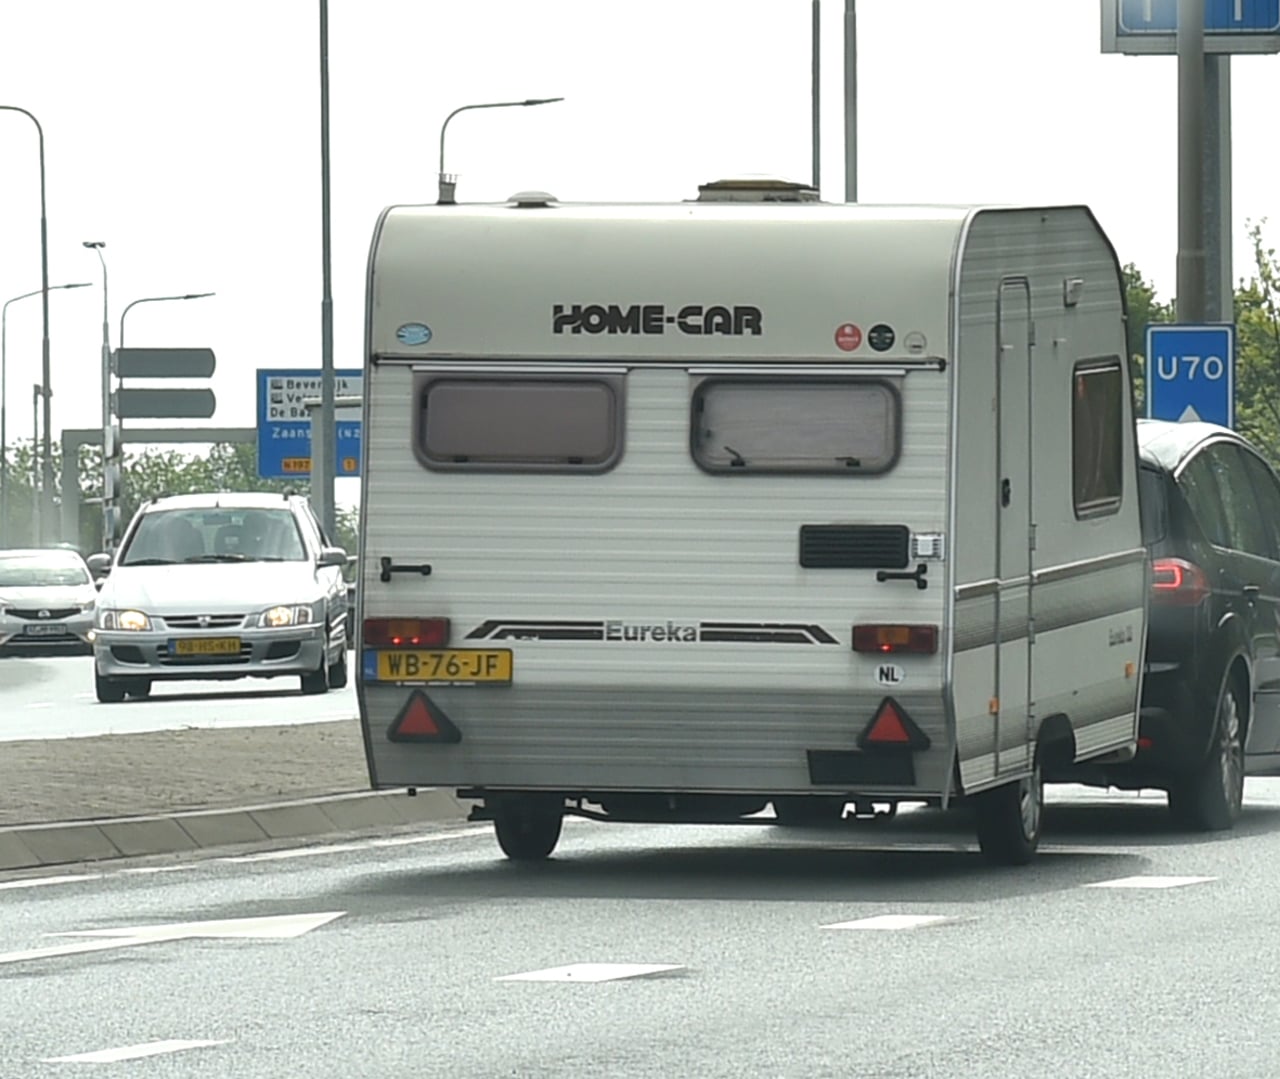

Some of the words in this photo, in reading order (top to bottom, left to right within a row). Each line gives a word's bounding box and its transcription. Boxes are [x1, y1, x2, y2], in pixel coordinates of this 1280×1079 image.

[552, 304, 763, 336] HOME-CAR
[1157, 356, 1224, 381] U70
[606, 620, 697, 642] Eureka
[388, 653, 499, 677] WB-76-JF
[879, 666, 899, 682] NL
